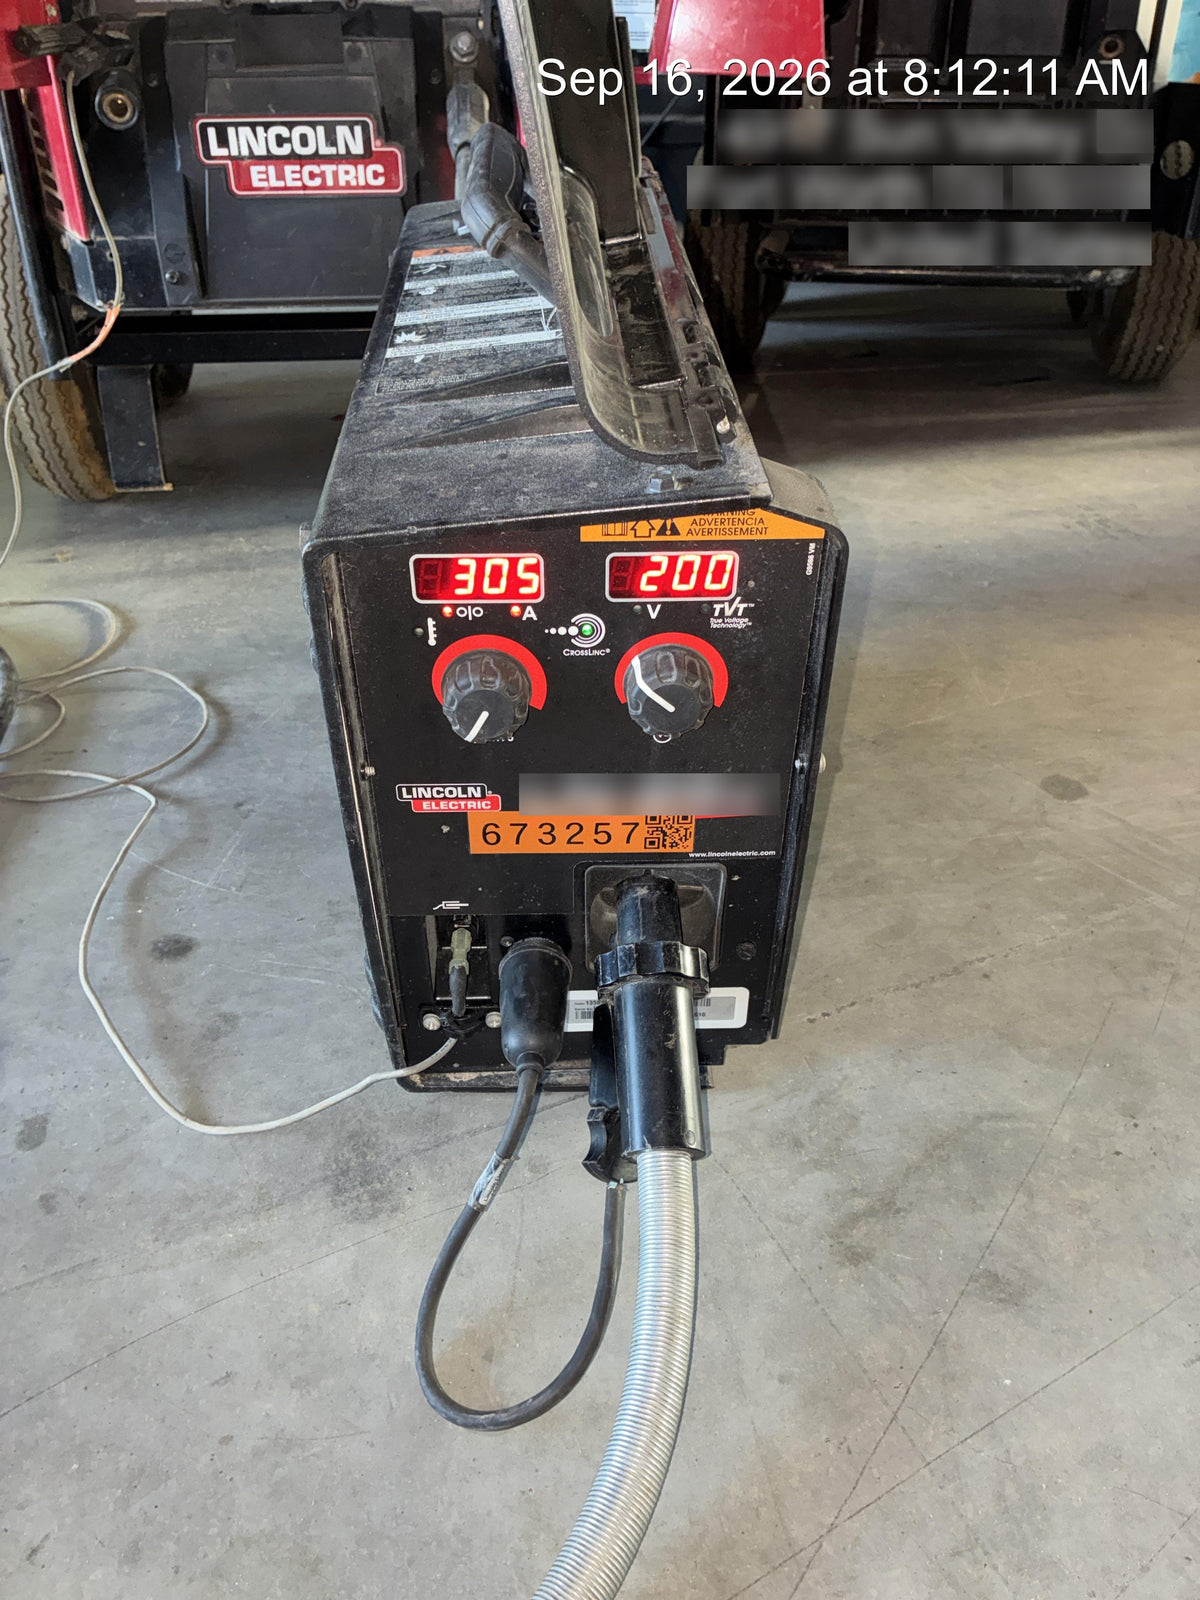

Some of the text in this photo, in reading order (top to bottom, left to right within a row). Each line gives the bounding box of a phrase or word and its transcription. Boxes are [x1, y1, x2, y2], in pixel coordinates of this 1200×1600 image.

[206, 124, 365, 157] LINCOLN
[249, 163, 386, 188] ELECTRIC
[690, 517, 765, 527] ADVERTENCIA
[686, 526, 769, 537] AVERTISSEMENT
[454, 557, 540, 595] 305
[640, 554, 734, 592] 200
[521, 605, 538, 621] A
[647, 604, 662, 620] V
[402, 786, 482, 799] LINCOLN
[422, 800, 492, 810] ELECTRIC
[481, 822, 640, 846] 673257
[688, 850, 776, 858] www.lincolnelectric.com
